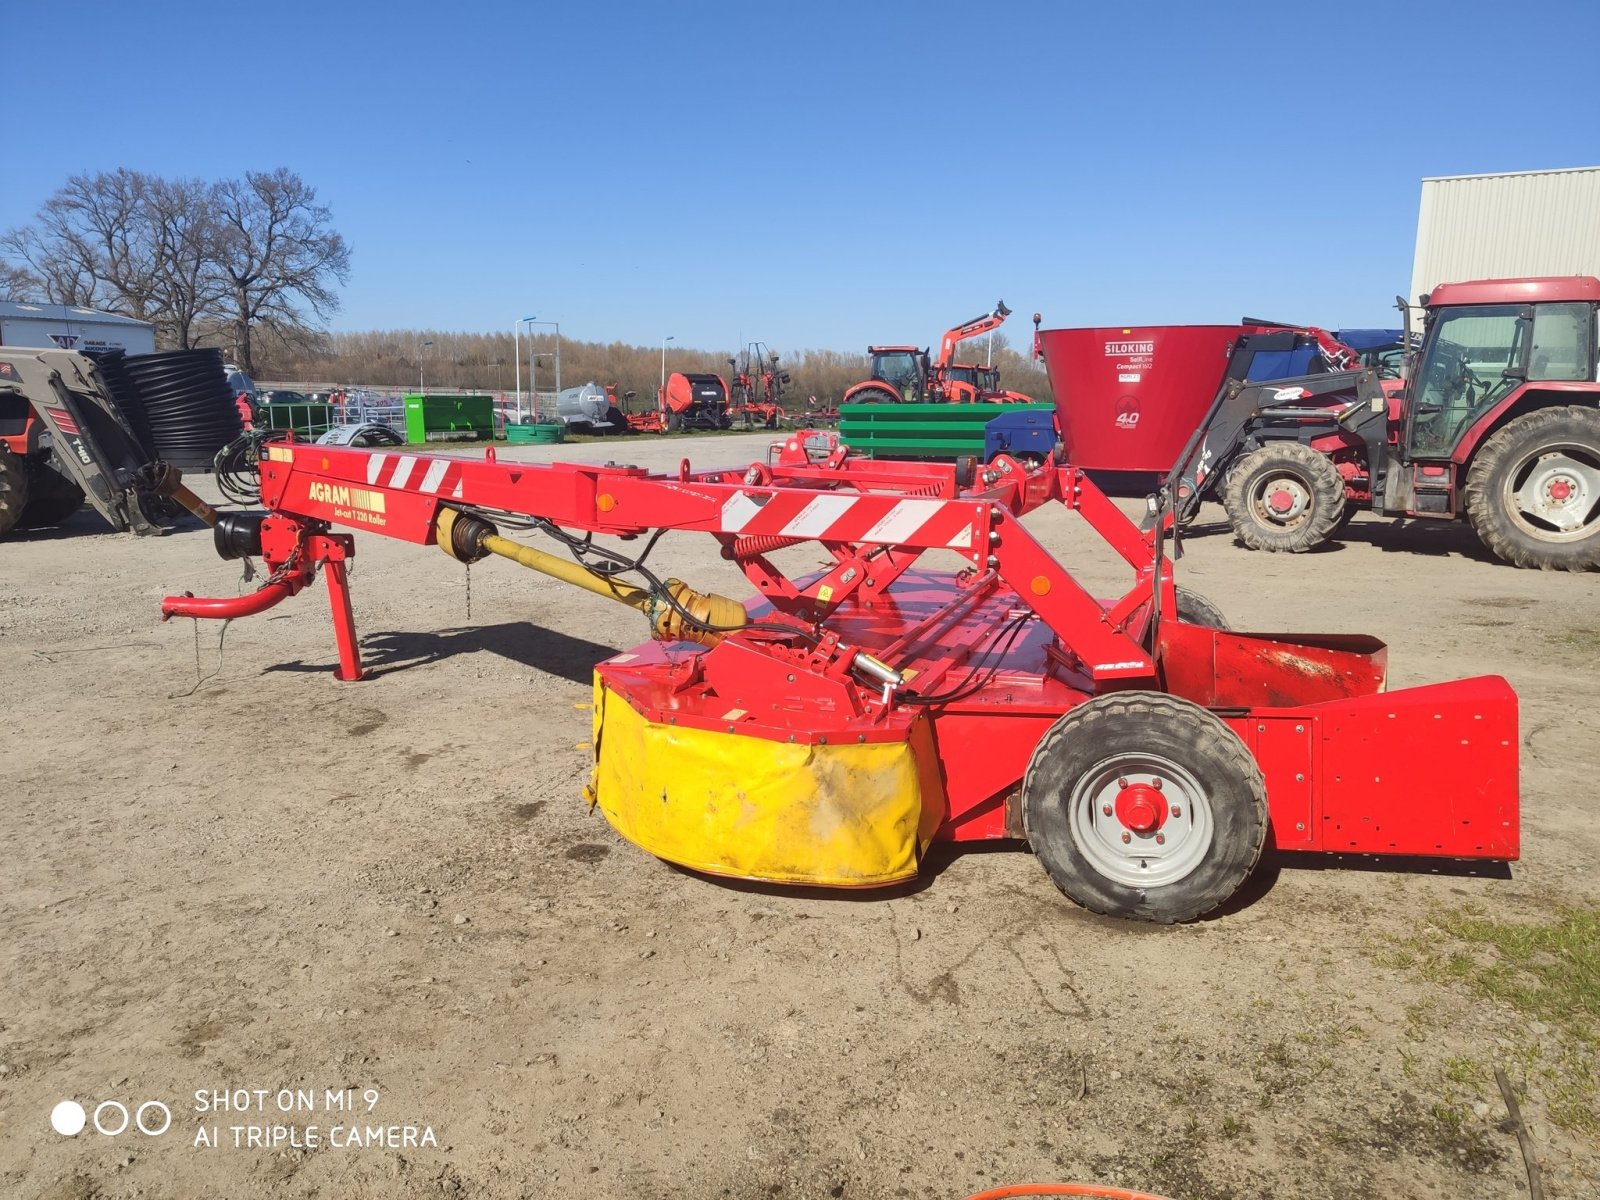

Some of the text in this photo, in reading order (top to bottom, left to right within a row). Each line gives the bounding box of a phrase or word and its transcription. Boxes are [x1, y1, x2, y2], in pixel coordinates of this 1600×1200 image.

[1105, 343, 1154, 353] SILOKING
[1116, 363, 1142, 371] Compact
[72, 437, 91, 464] T410
[308, 481, 350, 507] AGRAM
[356, 511, 368, 522] 320
[368, 513, 387, 526] Roller
